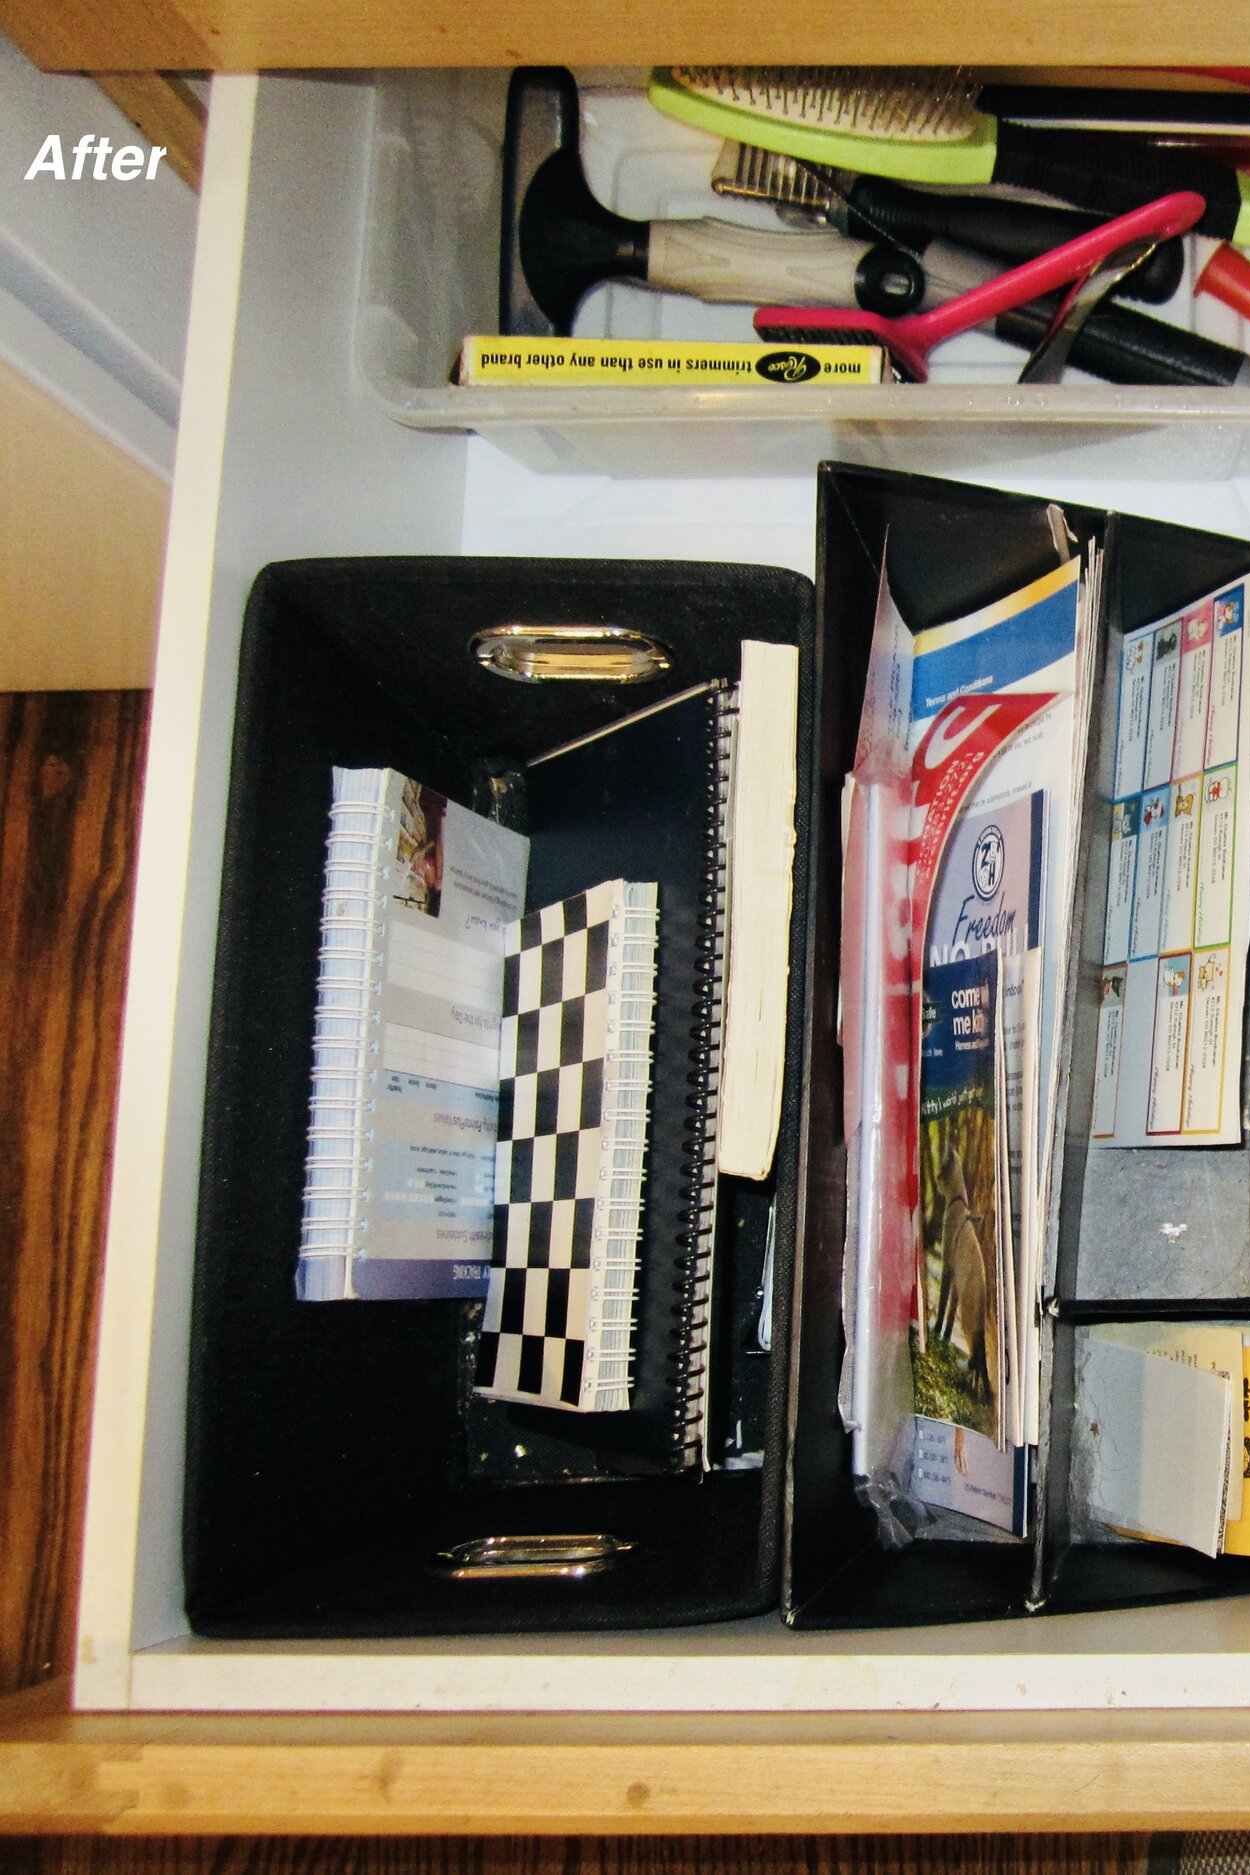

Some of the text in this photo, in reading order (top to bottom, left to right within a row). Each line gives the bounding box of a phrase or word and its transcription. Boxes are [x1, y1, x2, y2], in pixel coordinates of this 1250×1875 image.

[481, 353, 522, 369] brand
[526, 354, 565, 369] other
[570, 352, 596, 367] any
[601, 357, 633, 372] than
[638, 357, 663, 369] use
[668, 358, 680, 373] in
[686, 359, 752, 375] trimmers
[824, 362, 861, 374] more
[926, 694, 946, 708] Terms
[959, 674, 993, 694] Conditions
[952, 891, 1016, 946] Freedom
[930, 940, 971, 968] NO
[952, 987, 981, 1010] come
[953, 1014, 971, 1036] me
[1205, 1020, 1209, 1029] CO
[1188, 1064, 1196, 1092] Happy
[452, 1264, 481, 1280] TRACKING
